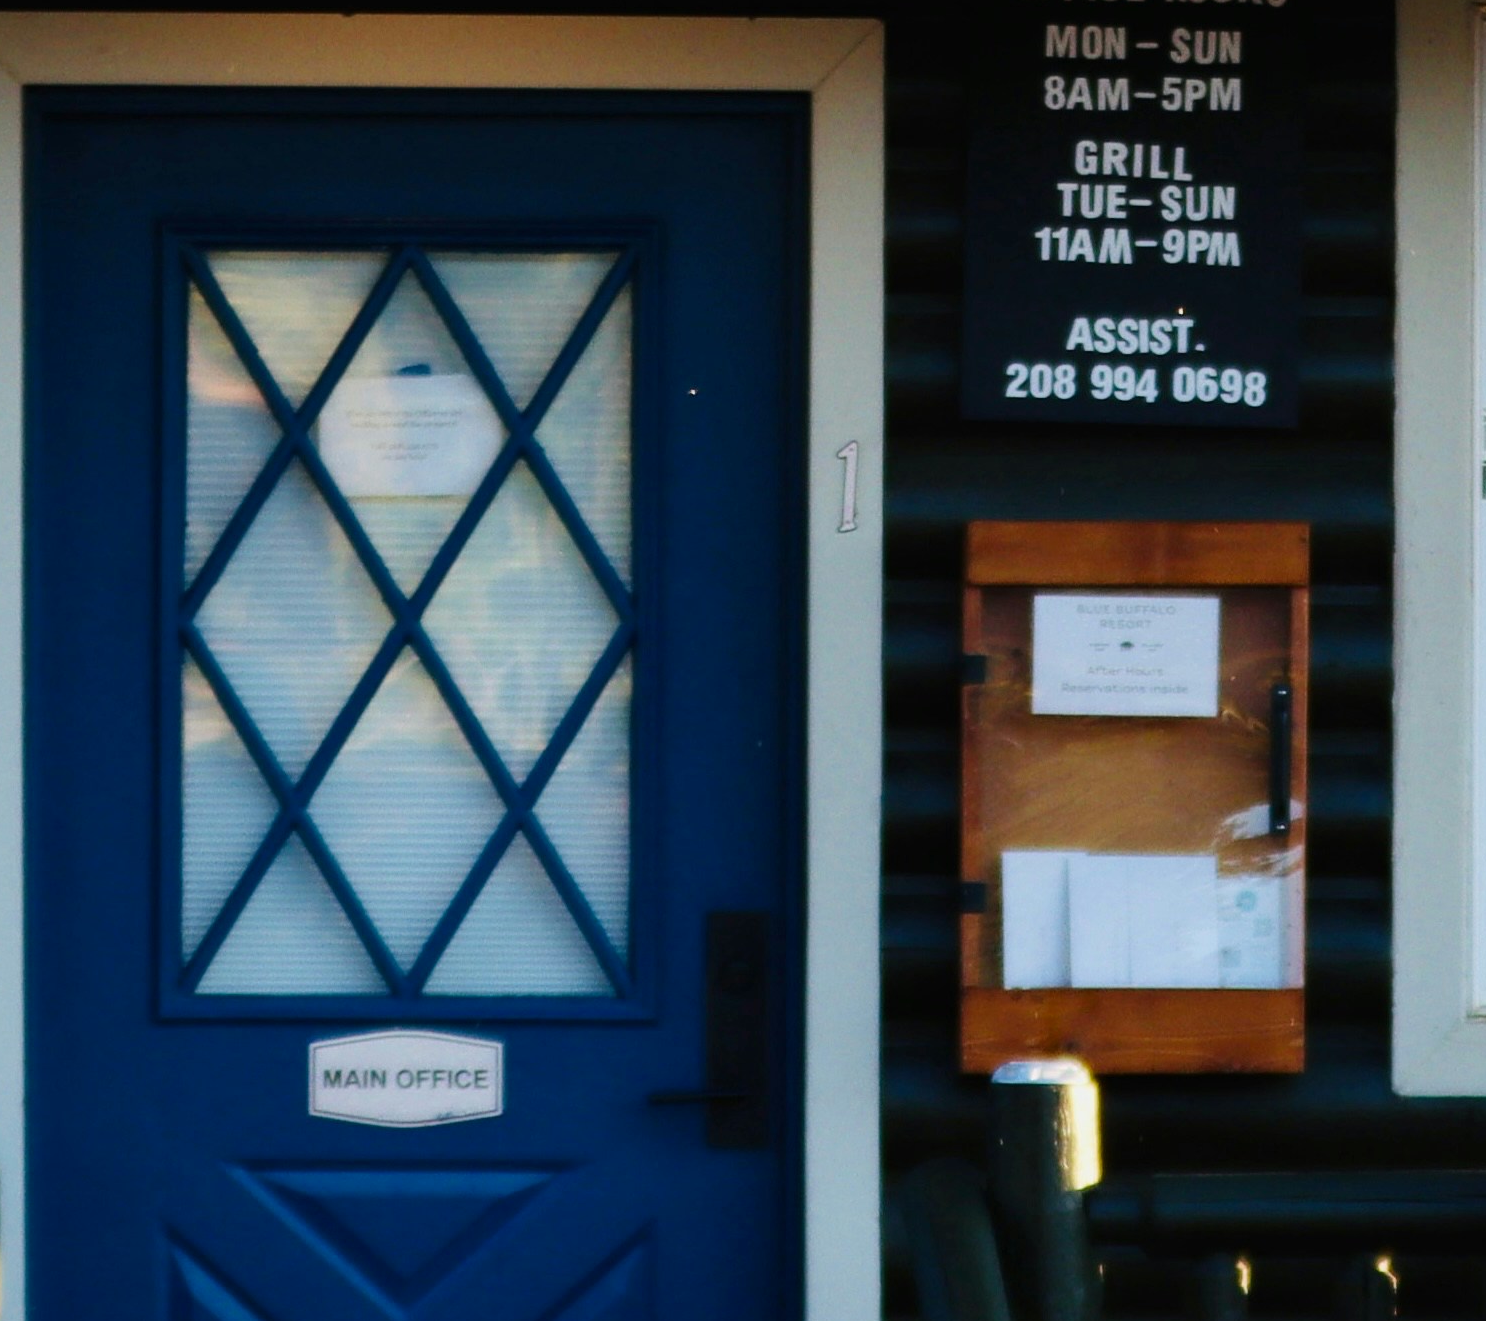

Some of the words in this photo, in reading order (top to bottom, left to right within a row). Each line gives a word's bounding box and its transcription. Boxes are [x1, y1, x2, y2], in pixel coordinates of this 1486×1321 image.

[1074, 140, 1193, 181] GRILL
[1065, 316, 1207, 356] ASSIST.
[1005, 362, 1076, 400] 208
[1090, 364, 1159, 403] 994
[1172, 365, 1267, 407] 0698
[1076, 604, 1110, 615] BLUE
[1115, 604, 1177, 616] BUFFALO
[1099, 619, 1152, 630] RESORT
[1087, 665, 1120, 676] After
[1061, 682, 1146, 695] Reservations
[323, 1069, 387, 1089] MAIN
[395, 1069, 489, 1089] OFFICE
